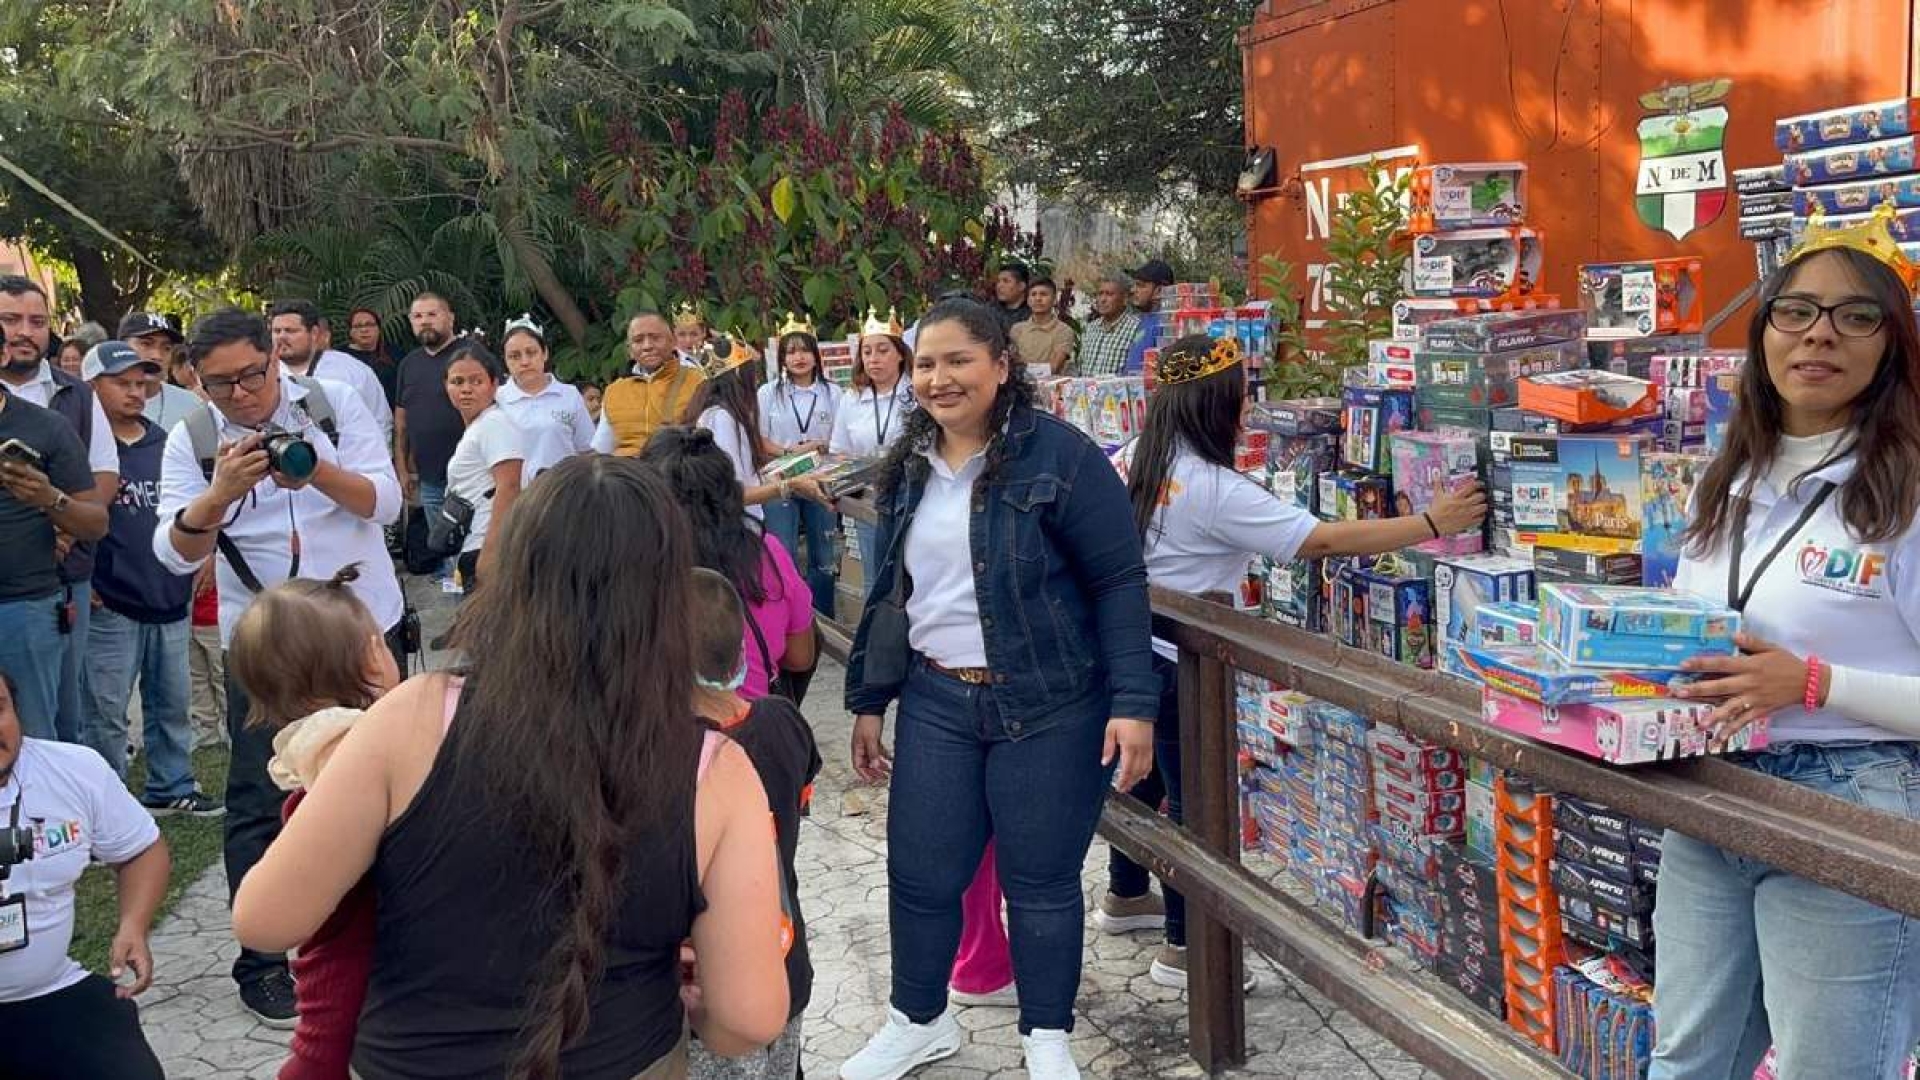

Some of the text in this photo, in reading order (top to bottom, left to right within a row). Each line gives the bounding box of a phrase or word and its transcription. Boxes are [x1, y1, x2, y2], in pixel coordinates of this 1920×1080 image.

[1645, 158, 1717, 187] N DE M
[1304, 177, 1330, 240] N
[1529, 487, 1550, 501] DIF
[1824, 548, 1886, 586] DIF
[46, 818, 82, 849] DIF
